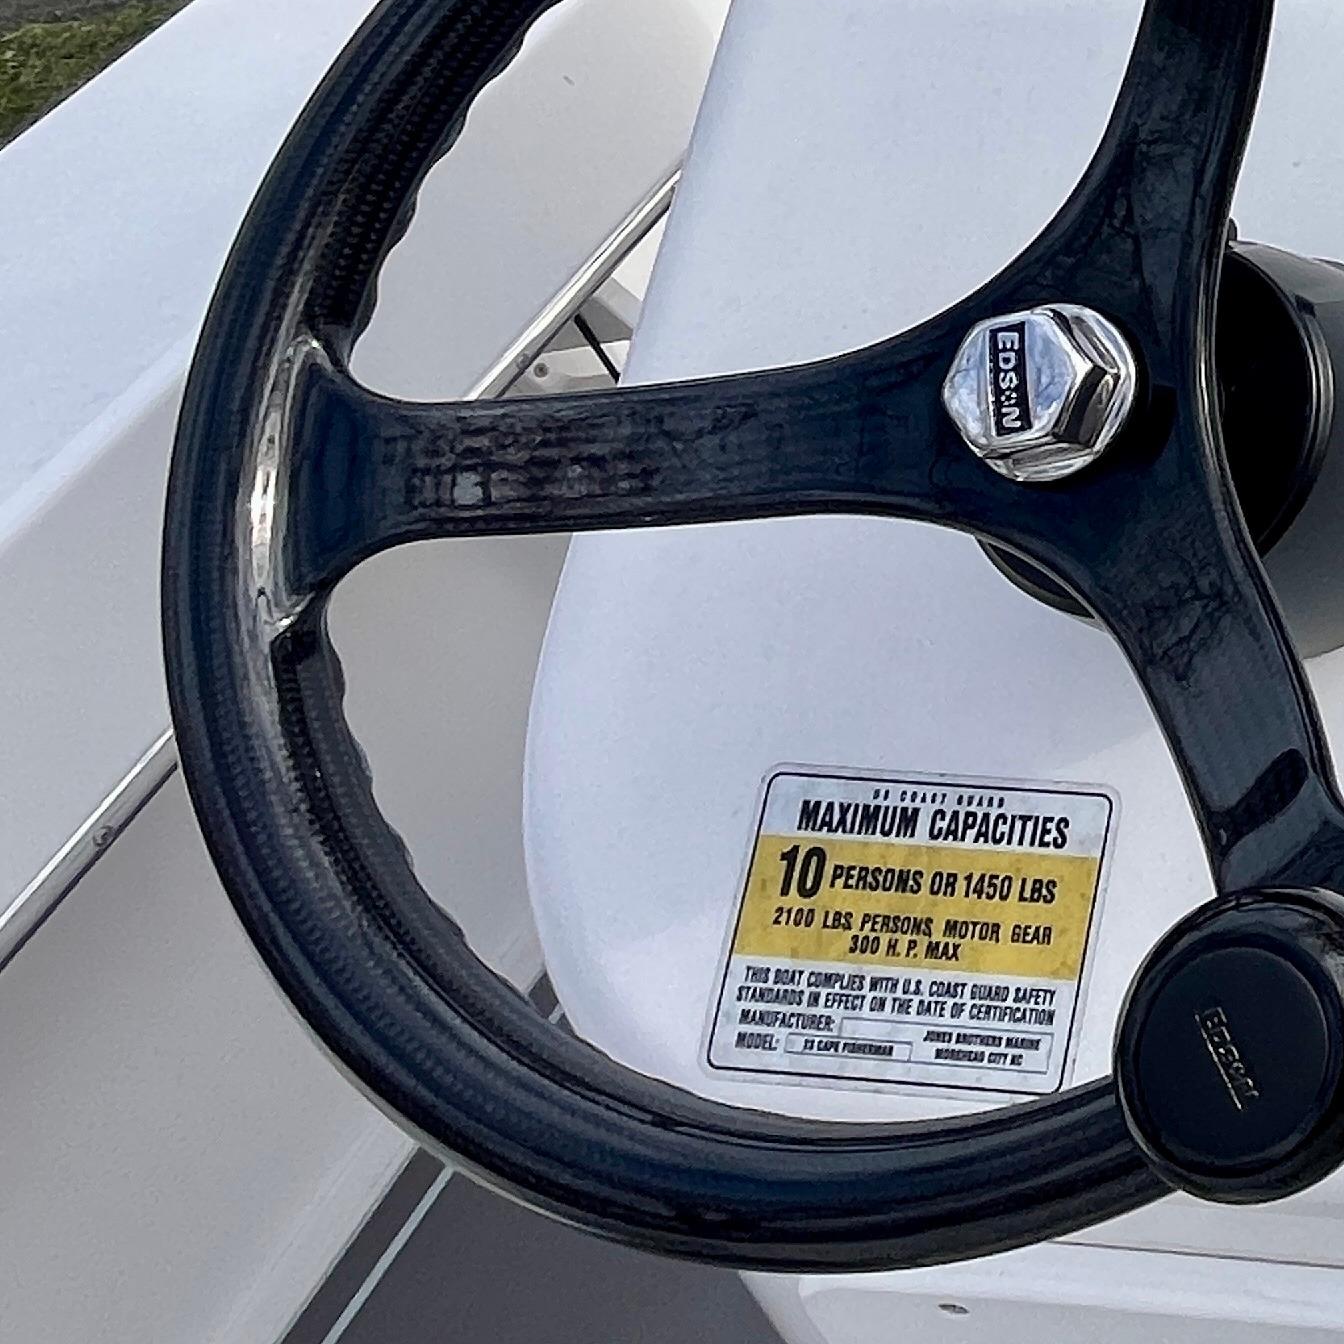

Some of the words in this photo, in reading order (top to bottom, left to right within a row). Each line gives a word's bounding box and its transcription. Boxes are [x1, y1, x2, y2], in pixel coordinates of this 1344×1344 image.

[996, 331, 1022, 429] EDSON
[900, 790, 948, 805] COAST
[797, 799, 920, 838] MAXIMUM
[928, 808, 1070, 849] CAPACITIES
[778, 844, 828, 899] 10
[829, 864, 924, 895] PERSONS
[929, 870, 958, 897] OR
[963, 872, 1012, 902] 1450
[1018, 877, 1058, 904] LBS
[772, 906, 815, 927] 2100
[821, 910, 854, 931] LBS
[859, 913, 934, 937] PERSONS
[943, 919, 1001, 943] MOTOR
[1010, 924, 1053, 945] GEAR
[848, 935, 880, 955] 300
[886, 939, 901, 957] H.
[905, 940, 919, 958] P.
[925, 941, 961, 961] MAX
[736, 985, 804, 1006] STANDARDS
[806, 991, 821, 1008] IN
[824, 992, 867, 1011] EFFECT
[868, 995, 888, 1013] ON
[890, 997, 914, 1015] THE
[916, 999, 947, 1018] DATE
[950, 1002, 967, 1020] OF
[968, 1003, 1057, 1026] CERTIFICATION
[744, 965, 771, 984] THIS
[773, 968, 805, 986] BOAT
[806, 971, 866, 991] COMPLIES
[868, 976, 900, 994] WITH
[902, 977, 924, 996] U.S.
[928, 980, 968, 999] COAST
[970, 984, 1010, 1003] GUARD
[1012, 986, 1057, 1007] SAFETY
[738, 1008, 836, 1032] MANUFACTURER:
[734, 1031, 780, 1051] MODEL:
